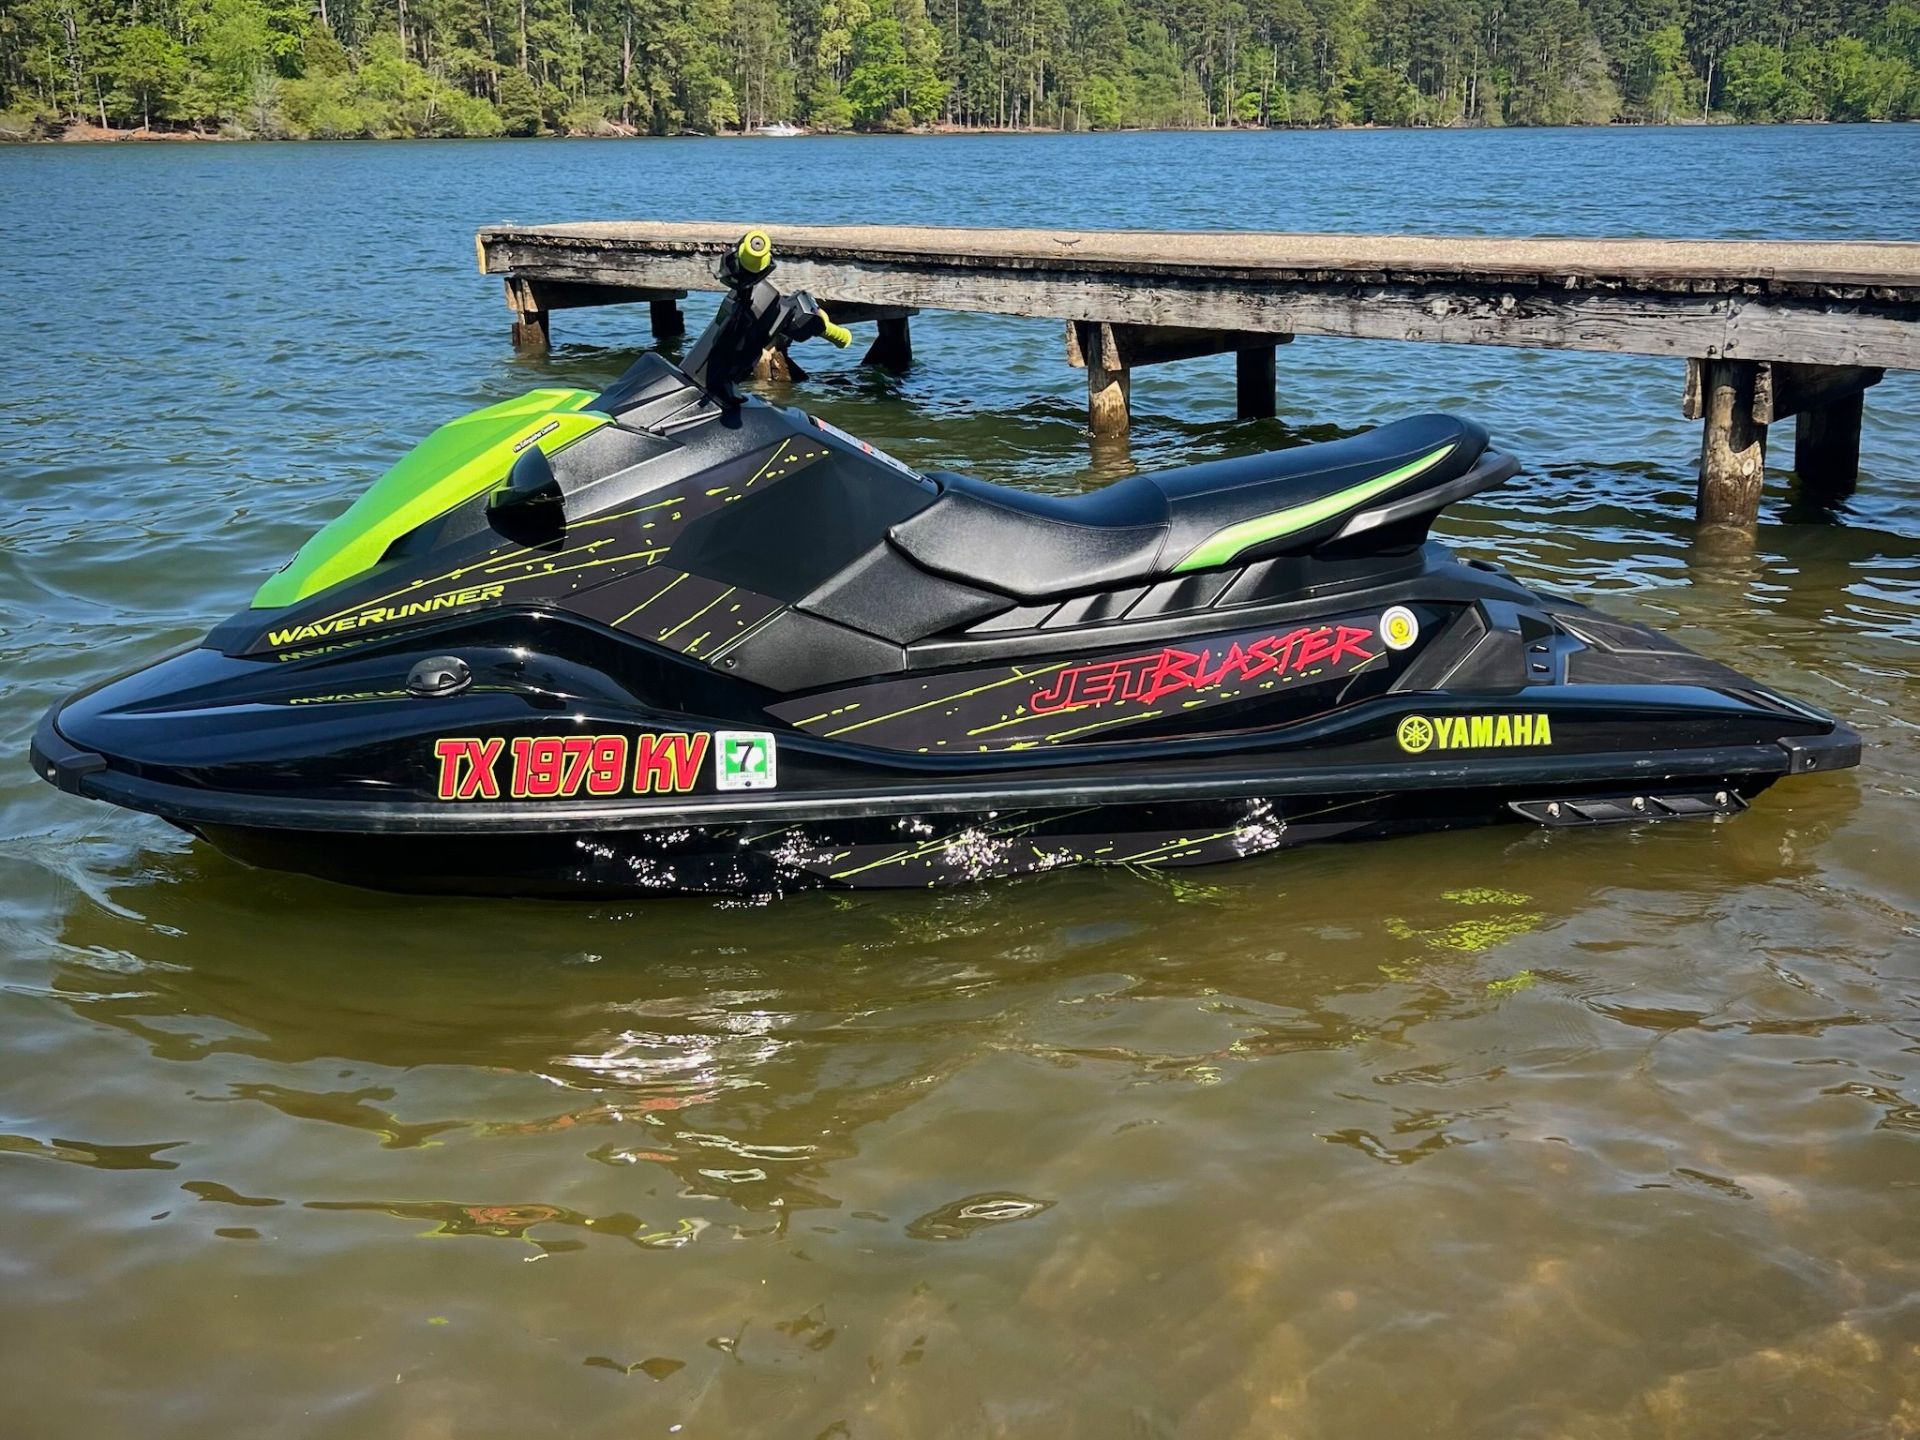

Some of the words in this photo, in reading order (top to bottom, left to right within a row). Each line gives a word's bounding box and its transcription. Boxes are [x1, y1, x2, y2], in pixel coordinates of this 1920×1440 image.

[1433, 714, 1552, 749] YAMAHA
[435, 737, 505, 800] TX
[511, 734, 627, 798] 1979
[632, 731, 710, 795] KV
[736, 742, 754, 772] 7
